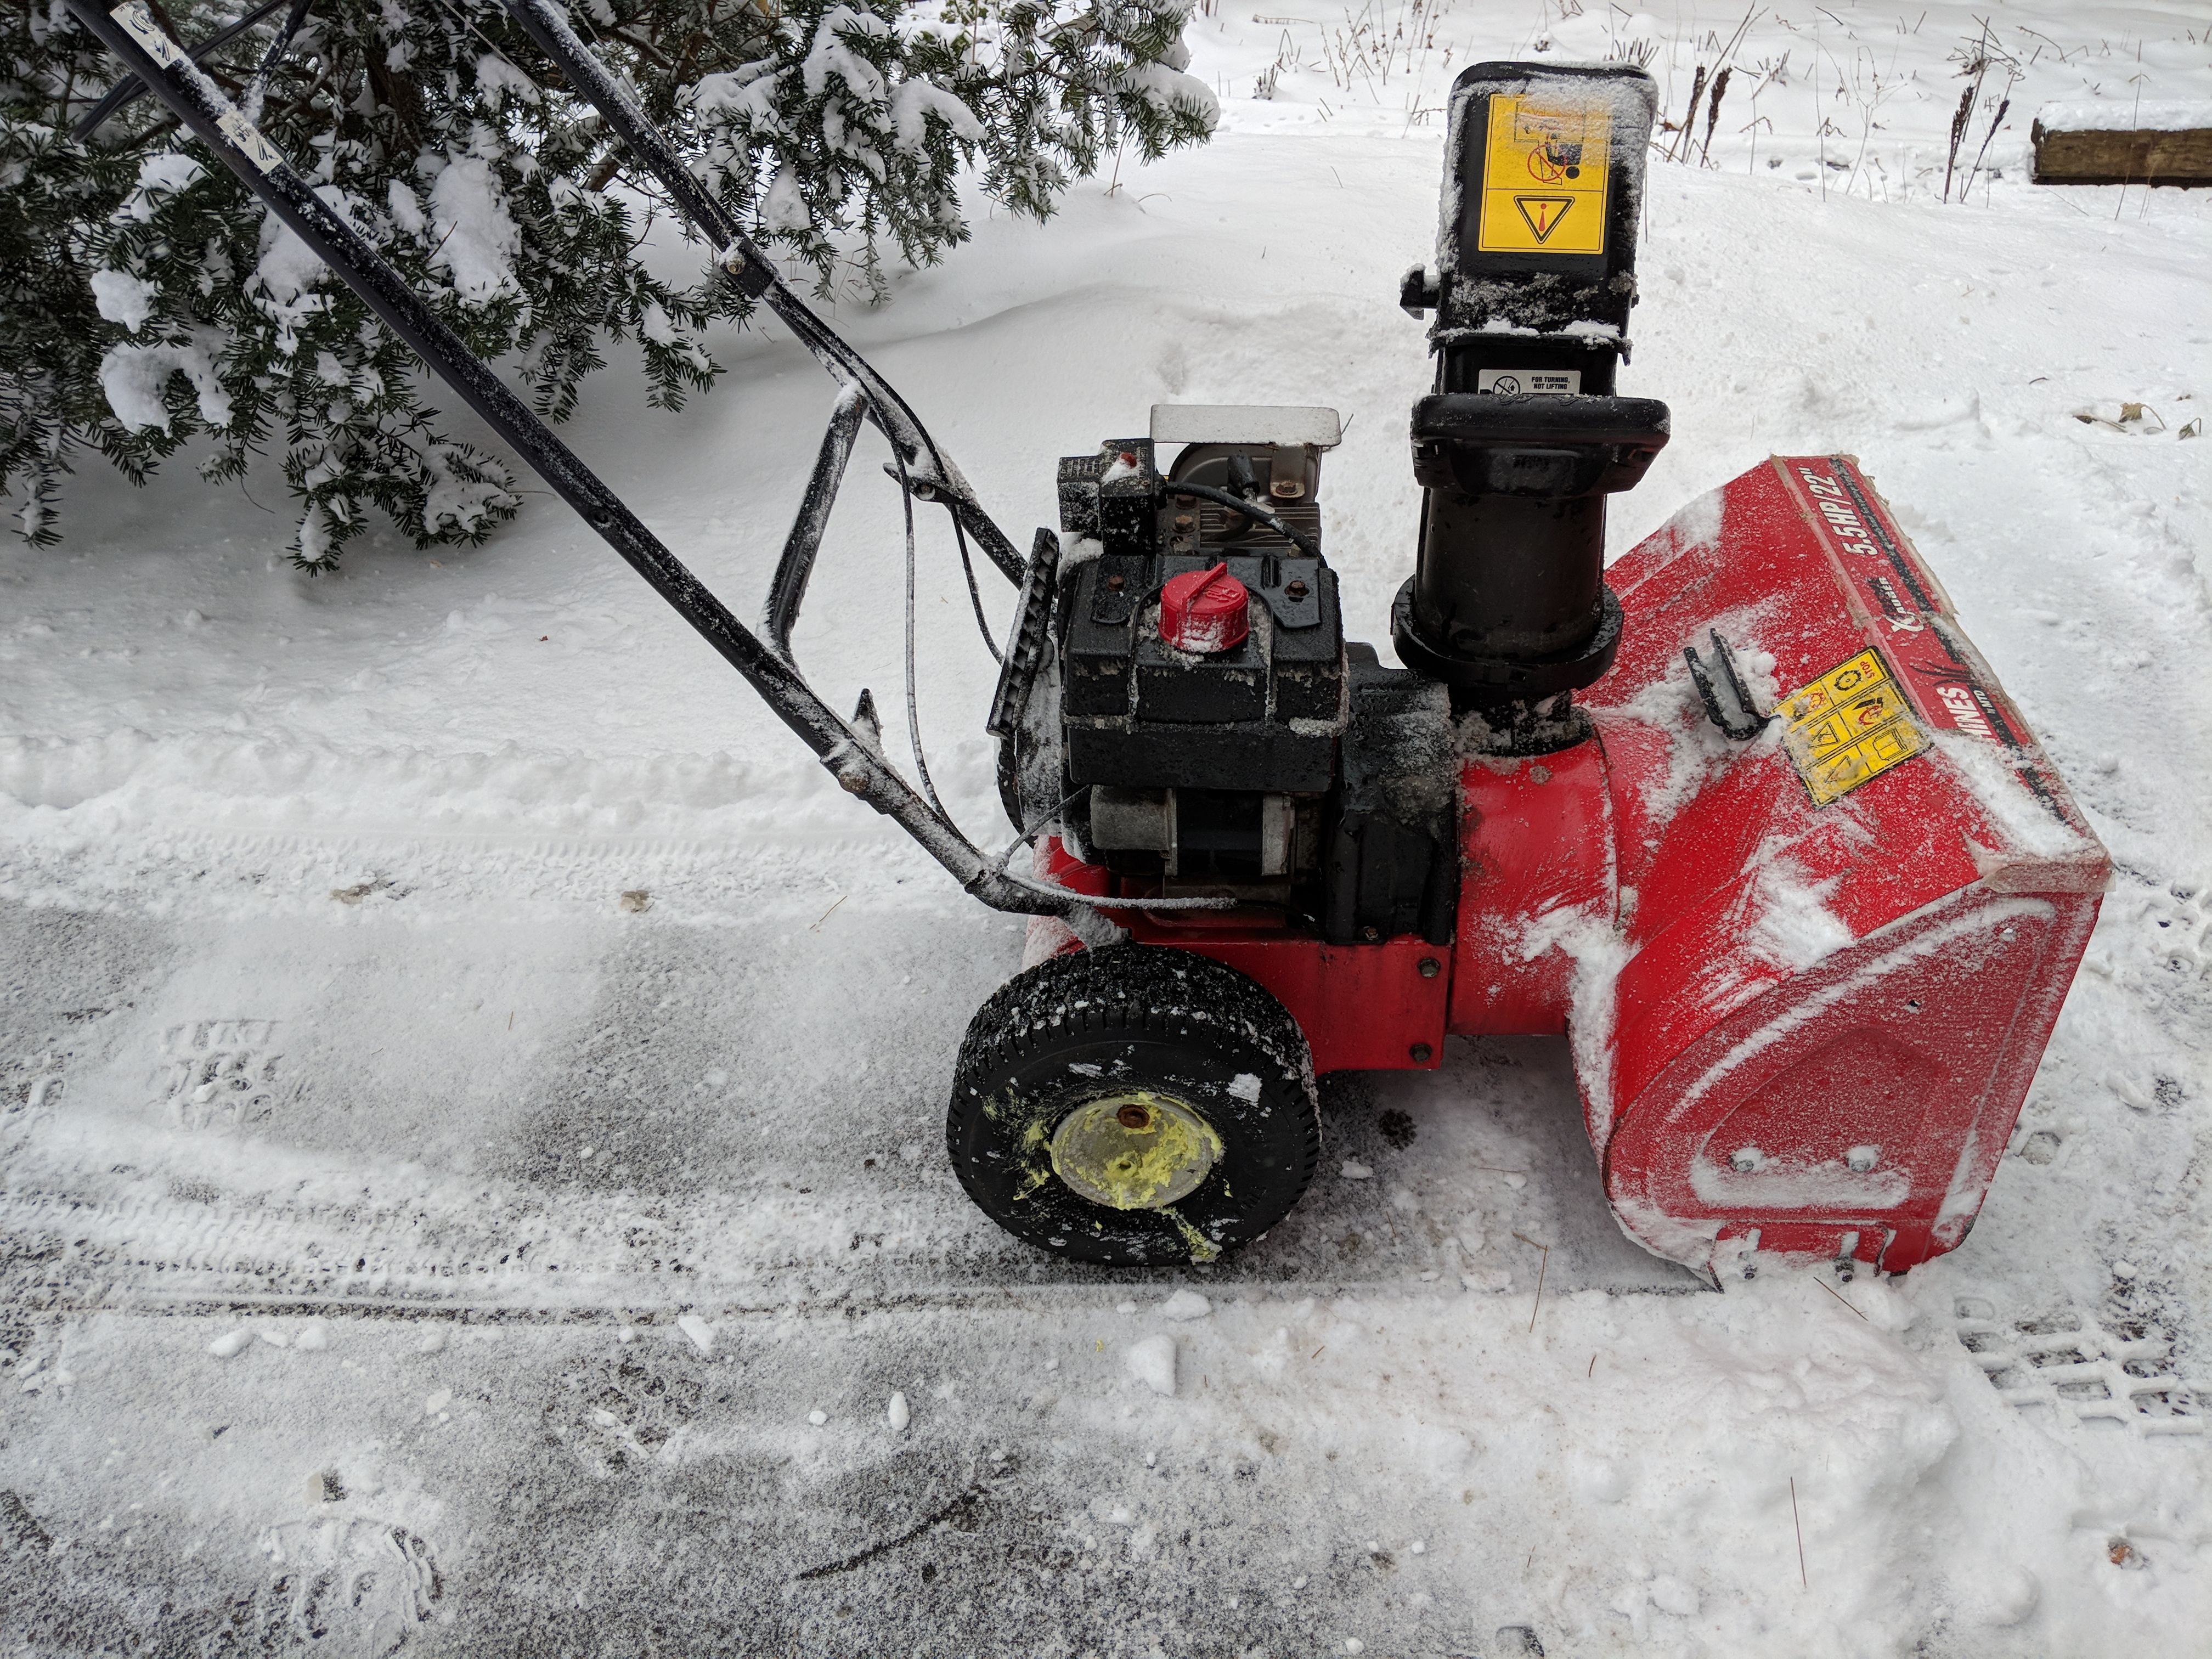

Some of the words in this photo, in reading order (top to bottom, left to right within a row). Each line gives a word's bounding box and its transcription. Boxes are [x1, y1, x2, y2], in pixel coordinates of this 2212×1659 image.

[1880, 575, 1908, 614] AUGER
[1859, 661, 1876, 679] STOP
[1973, 690, 1993, 708] MTD
